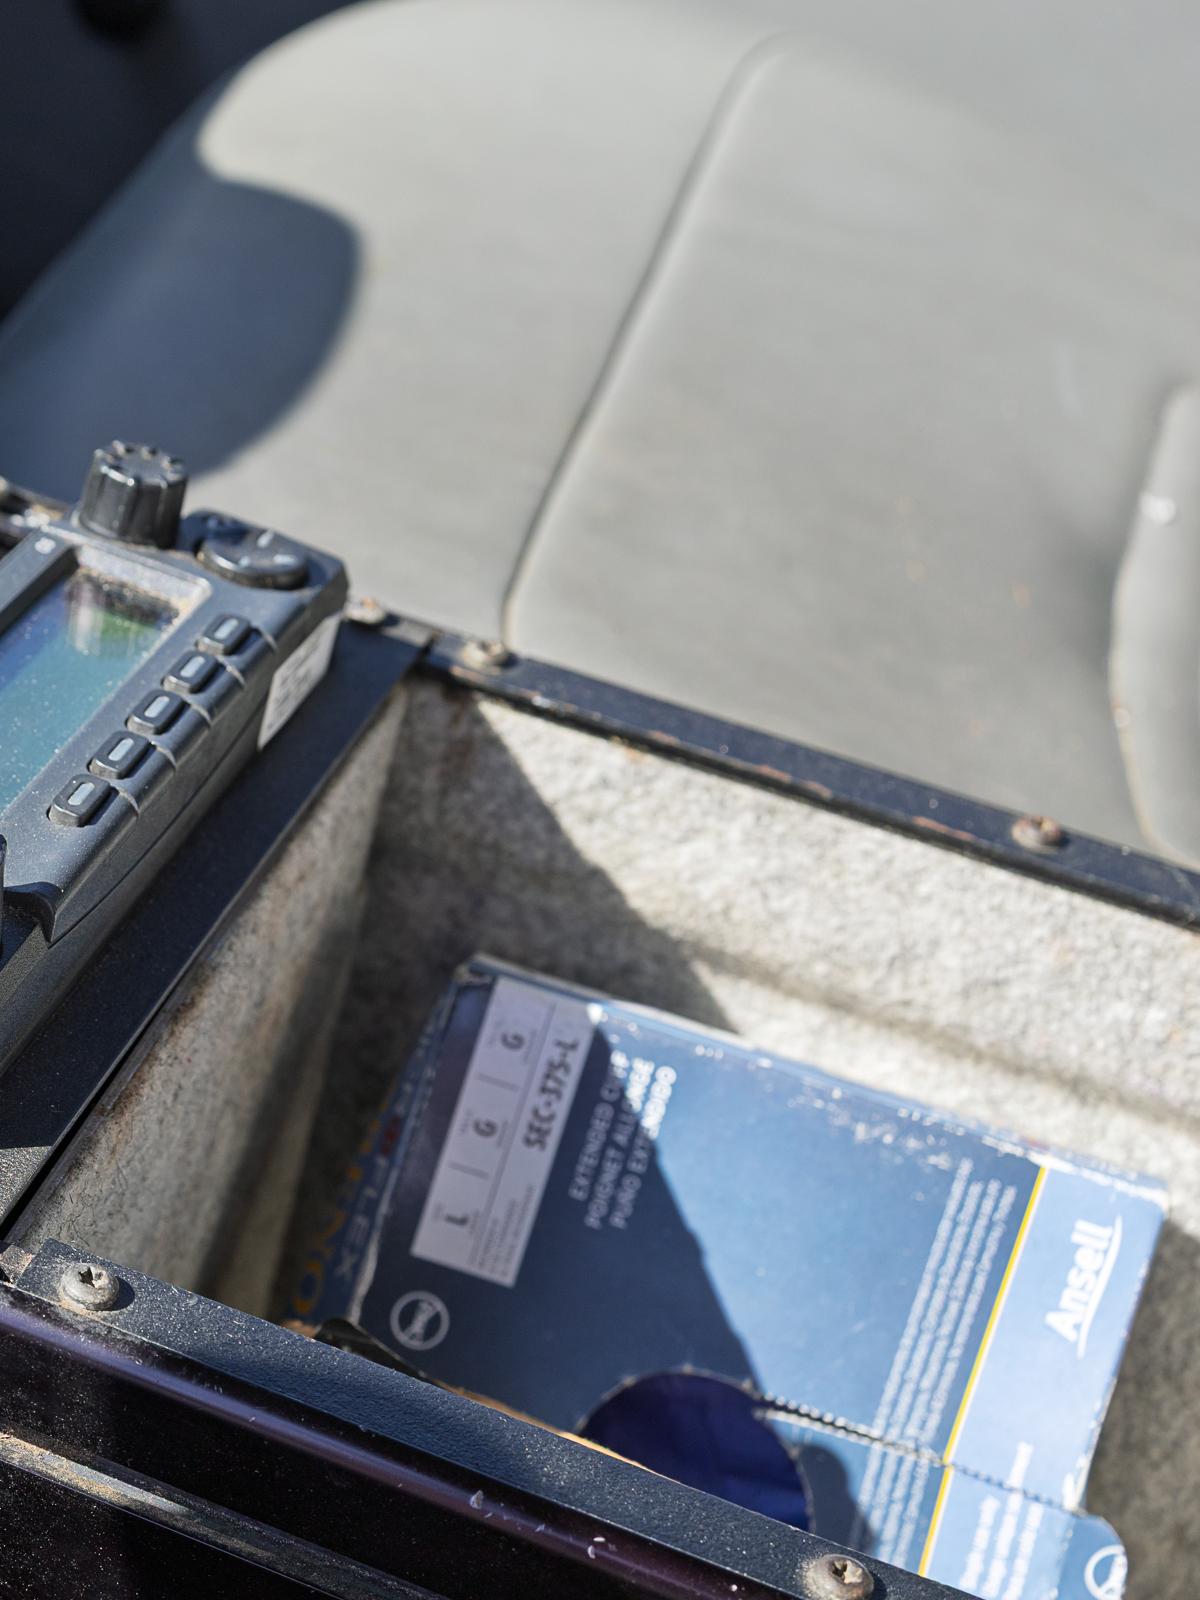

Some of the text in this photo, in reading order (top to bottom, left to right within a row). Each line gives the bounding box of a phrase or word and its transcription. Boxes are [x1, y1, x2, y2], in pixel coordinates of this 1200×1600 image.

[445, 1033, 525, 1226] L G G
[523, 1040, 580, 1151] SEC-375-L
[626, 1065, 677, 1173] EXTENDIDO
[568, 1101, 614, 1201] EXTENDED
[584, 1147, 625, 1230] POIGNET
[1045, 1218, 1113, 1344] Ansell
